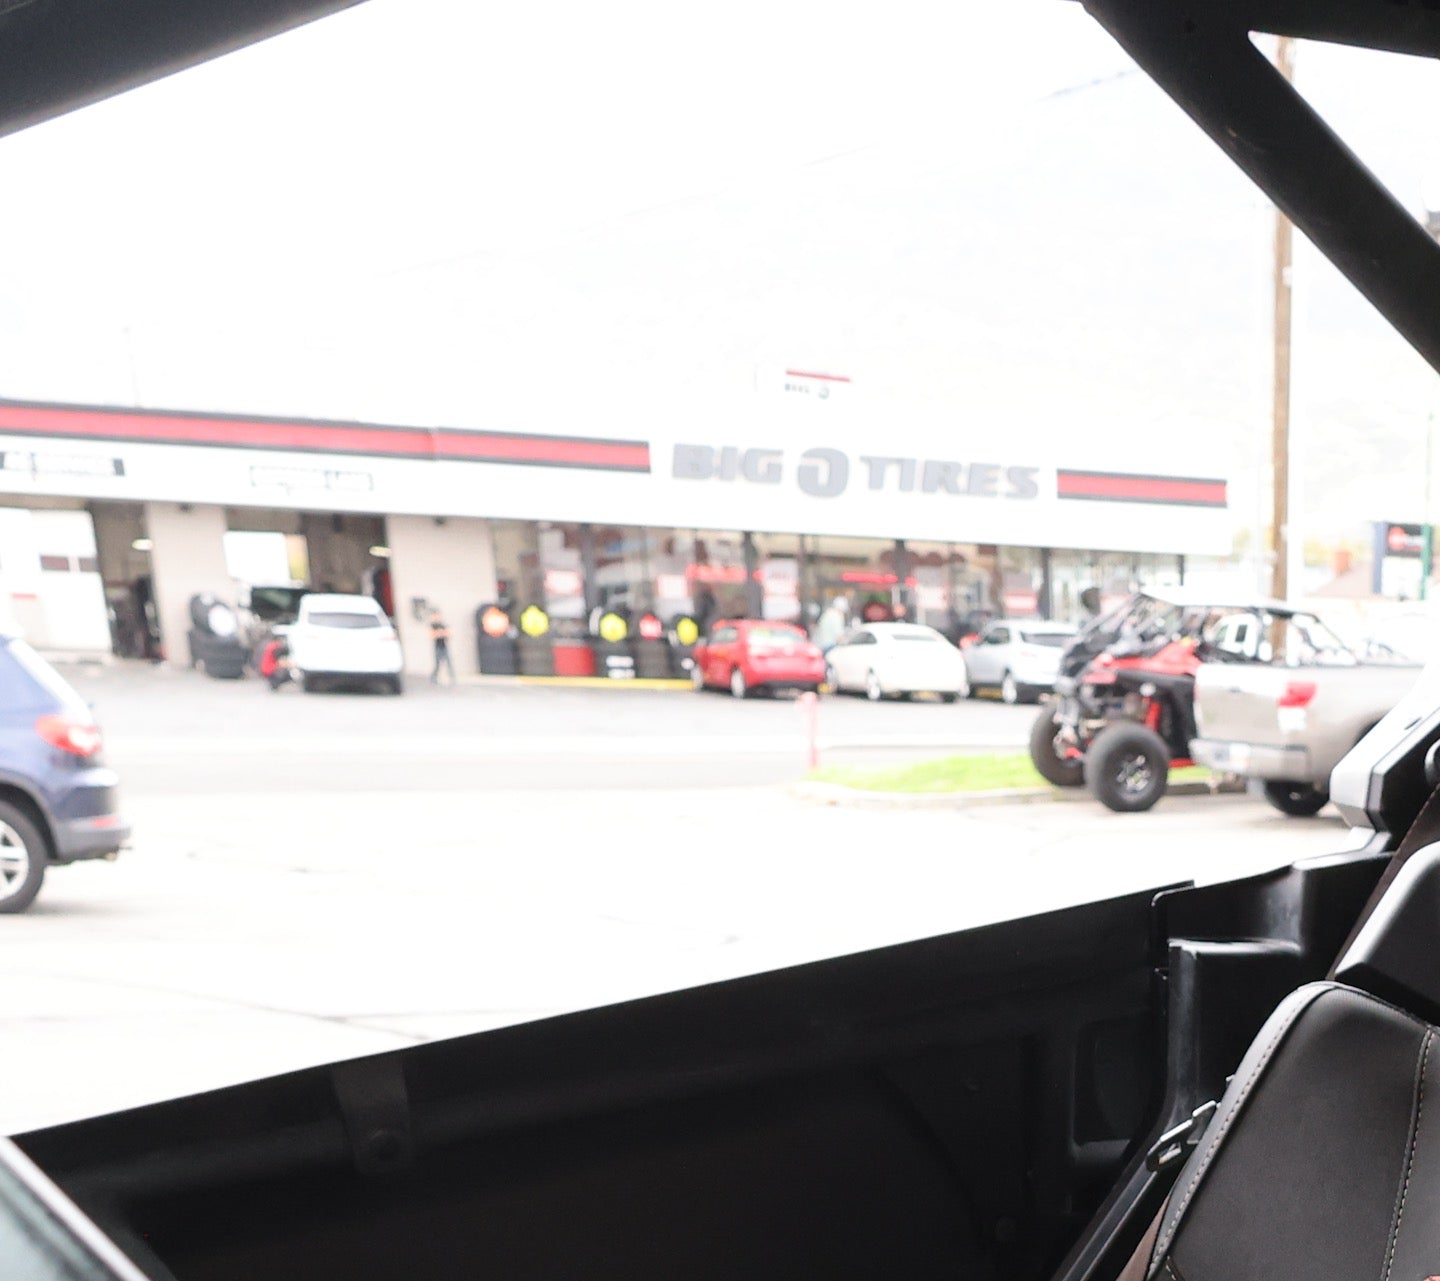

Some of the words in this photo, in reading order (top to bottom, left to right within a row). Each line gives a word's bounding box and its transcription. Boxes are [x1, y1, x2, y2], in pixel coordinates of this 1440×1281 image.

[672, 443, 785, 484] BIG
[796, 447, 851, 498] O
[859, 455, 1040, 499] TIRES
